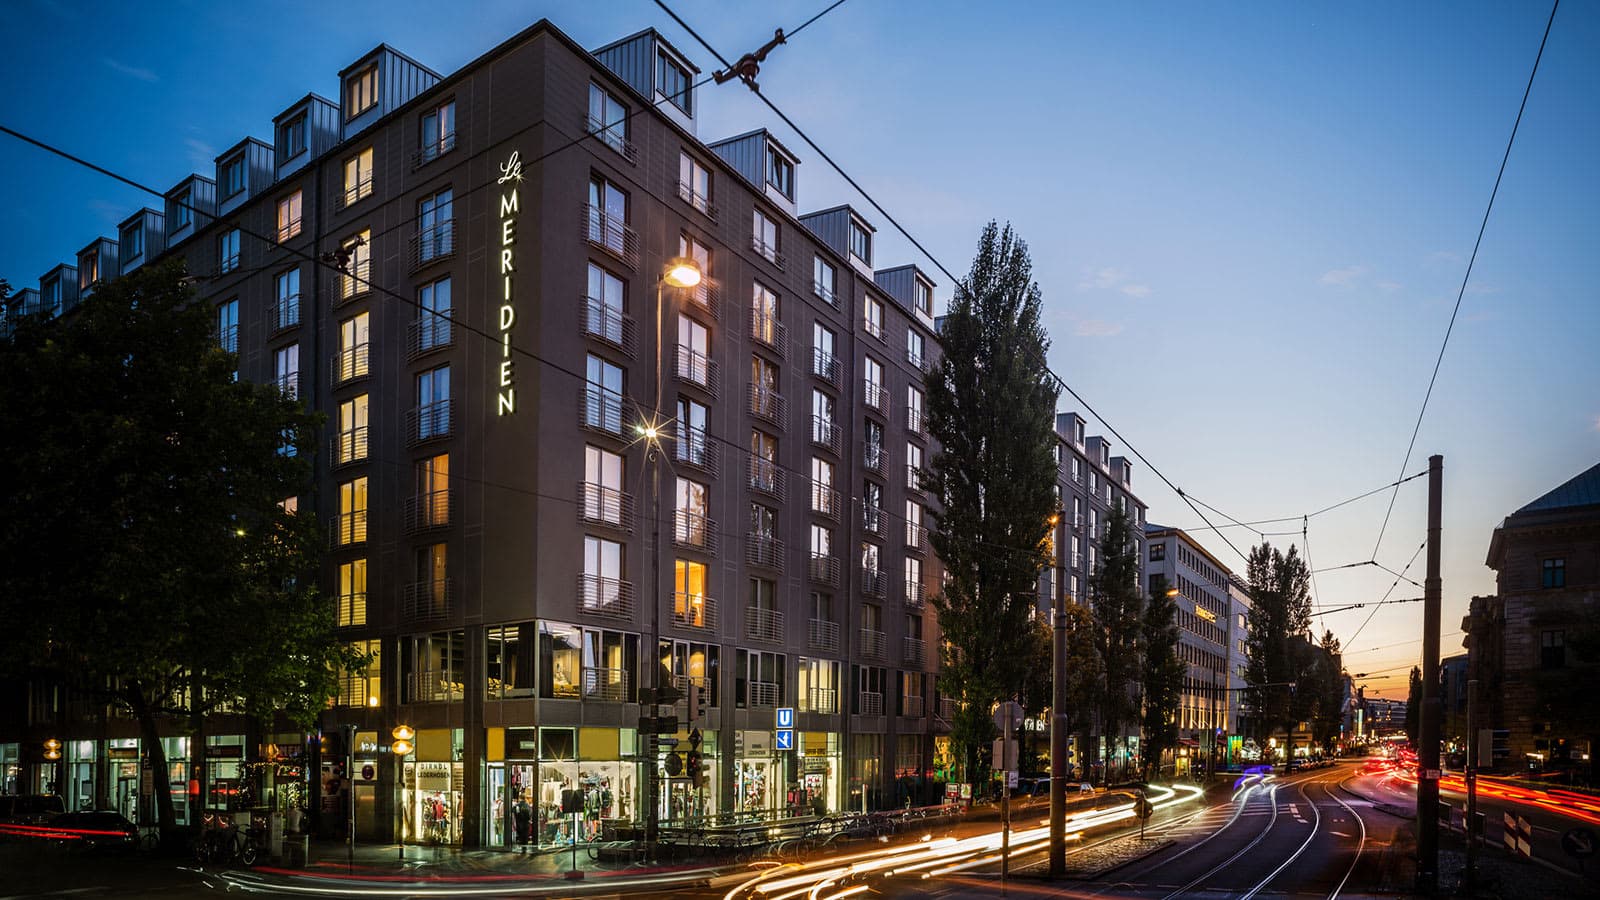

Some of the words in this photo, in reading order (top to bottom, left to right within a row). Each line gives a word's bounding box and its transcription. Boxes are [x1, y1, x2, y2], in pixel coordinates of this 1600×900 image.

[498, 151, 522, 185] Le
[498, 188, 518, 416] MERIDIEN
[779, 710, 790, 726] U
